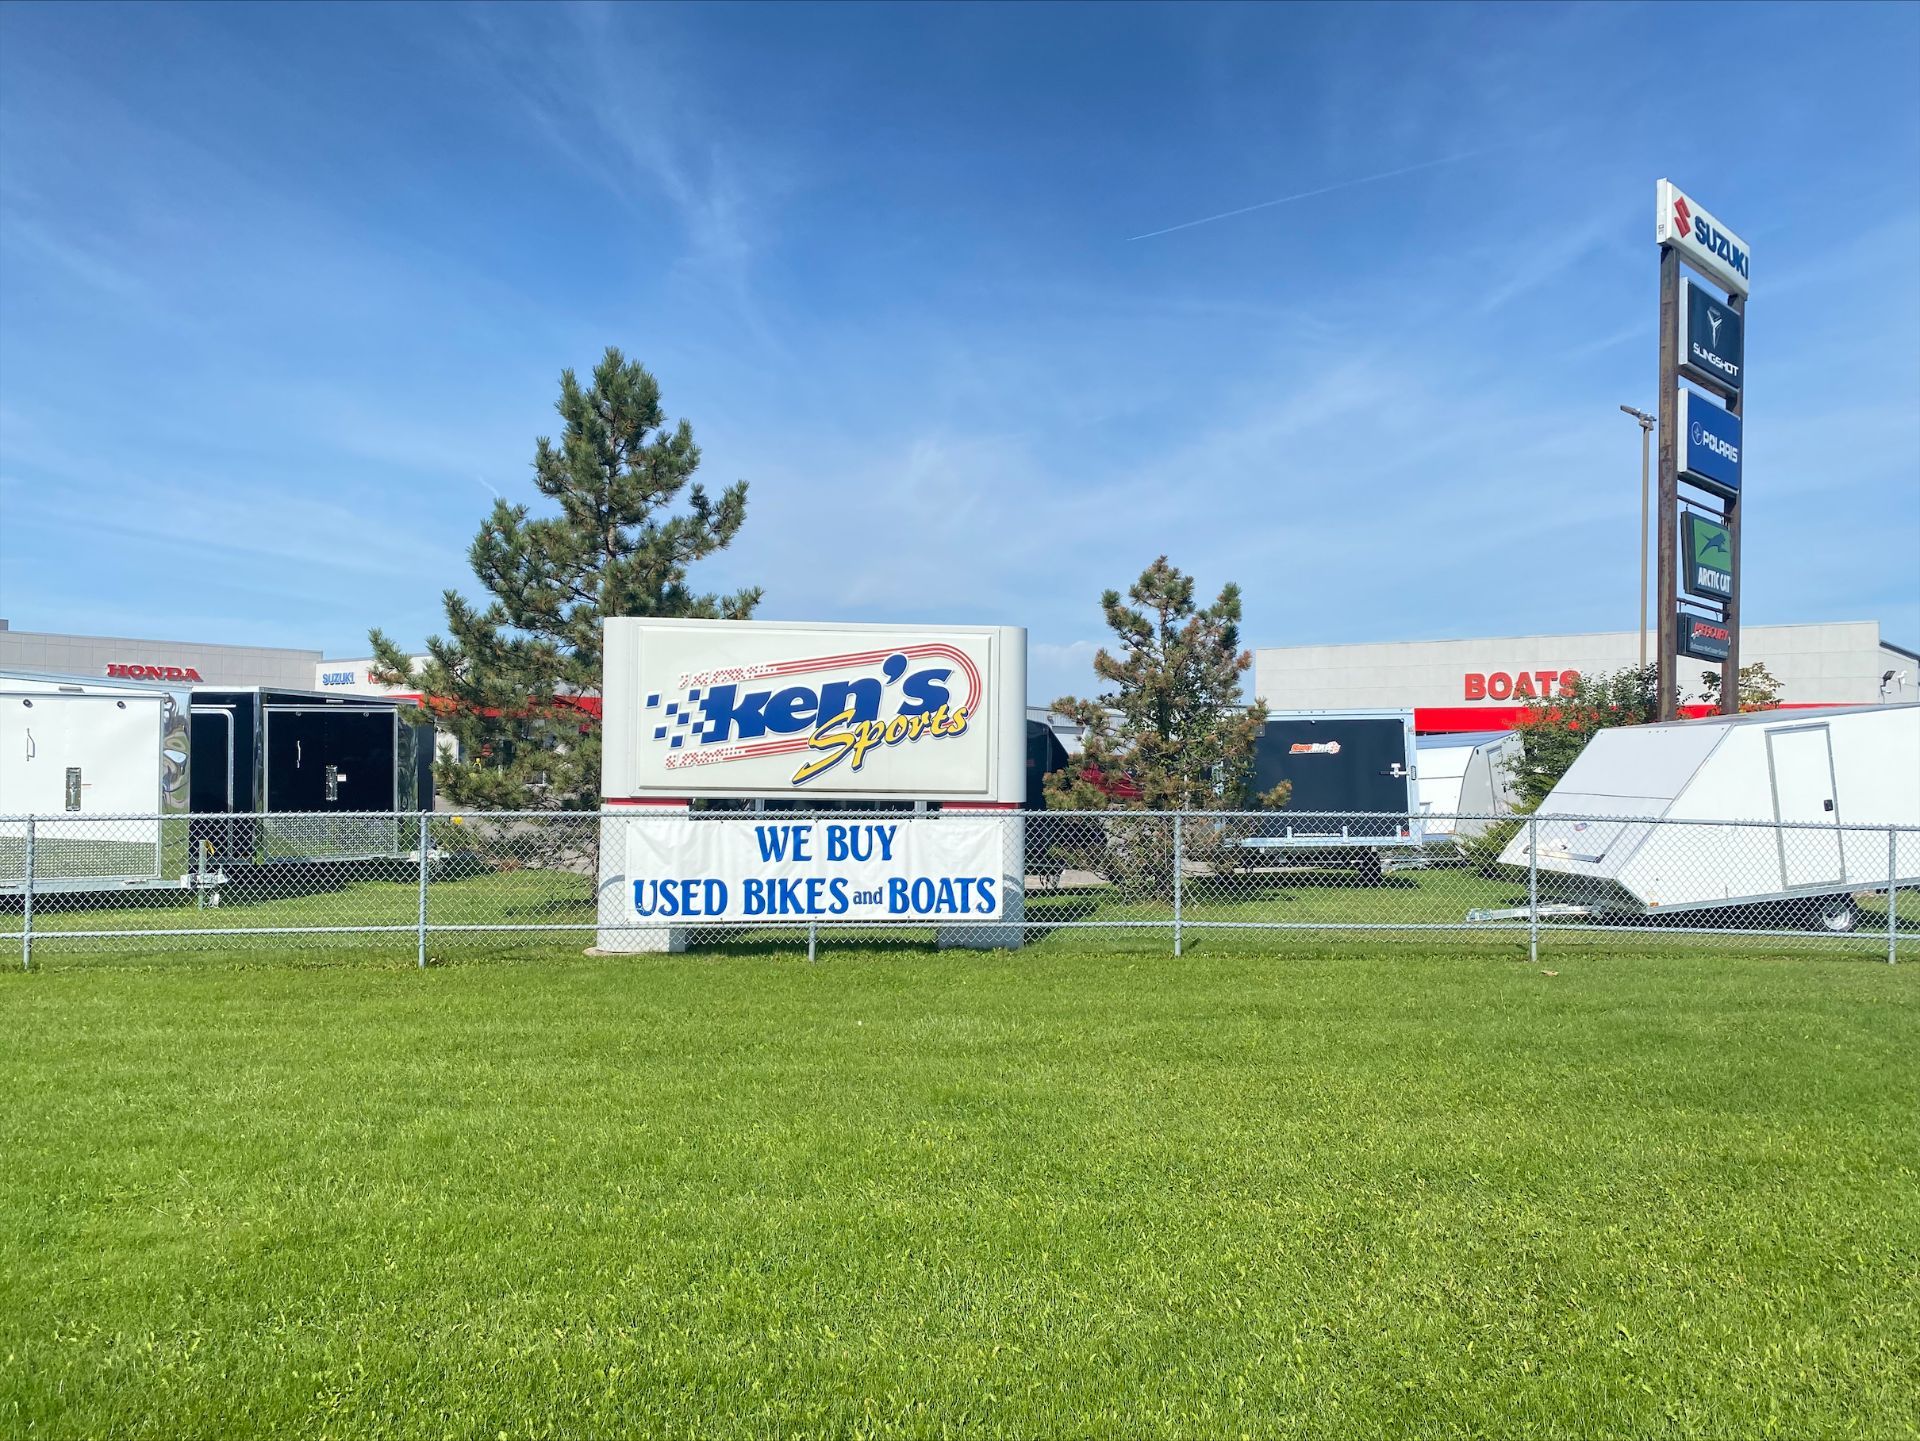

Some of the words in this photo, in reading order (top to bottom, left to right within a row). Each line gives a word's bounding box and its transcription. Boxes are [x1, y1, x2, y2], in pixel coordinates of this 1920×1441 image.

[1694, 215, 1749, 280] SUZUKI
[1693, 342, 1739, 377] SLINGSHOT
[1703, 429, 1738, 463] POLARIS
[1698, 567, 1719, 593] ARCTIC
[1720, 572, 1731, 596] CAT
[107, 663, 203, 682] HONDA
[322, 672, 355, 686] SUZUKI
[1464, 670, 1581, 700] BOATS
[700, 652, 955, 745] ken's
[790, 705, 972, 787] Sports
[755, 825, 813, 862] WE
[826, 825, 897, 861] BUY
[634, 878, 728, 916] USED
[742, 877, 849, 915] BIKES
[852, 886, 883, 905] and
[888, 876, 997, 914] BOATS
